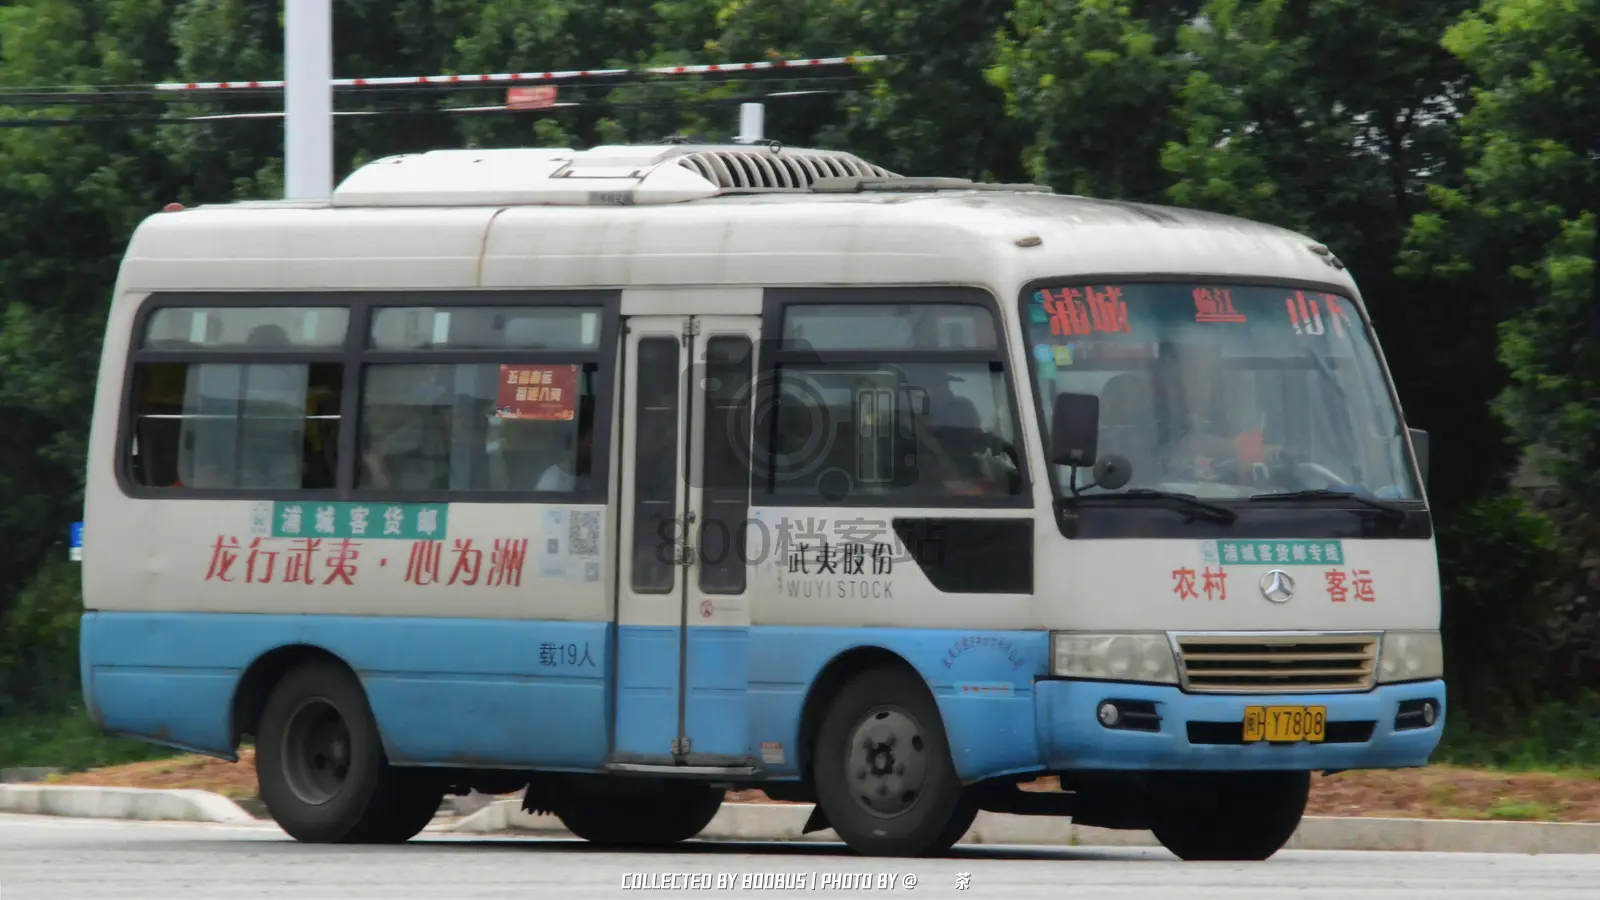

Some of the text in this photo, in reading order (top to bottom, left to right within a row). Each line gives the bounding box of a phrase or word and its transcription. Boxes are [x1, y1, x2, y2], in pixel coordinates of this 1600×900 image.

[280, 506, 439, 536] 浦城客货邮
[787, 542, 893, 575] 武夷股份
[788, 580, 894, 599] WUYI STOCK
[1172, 567, 1376, 603] 农村 客运
[539, 642, 597, 669] 载19人
